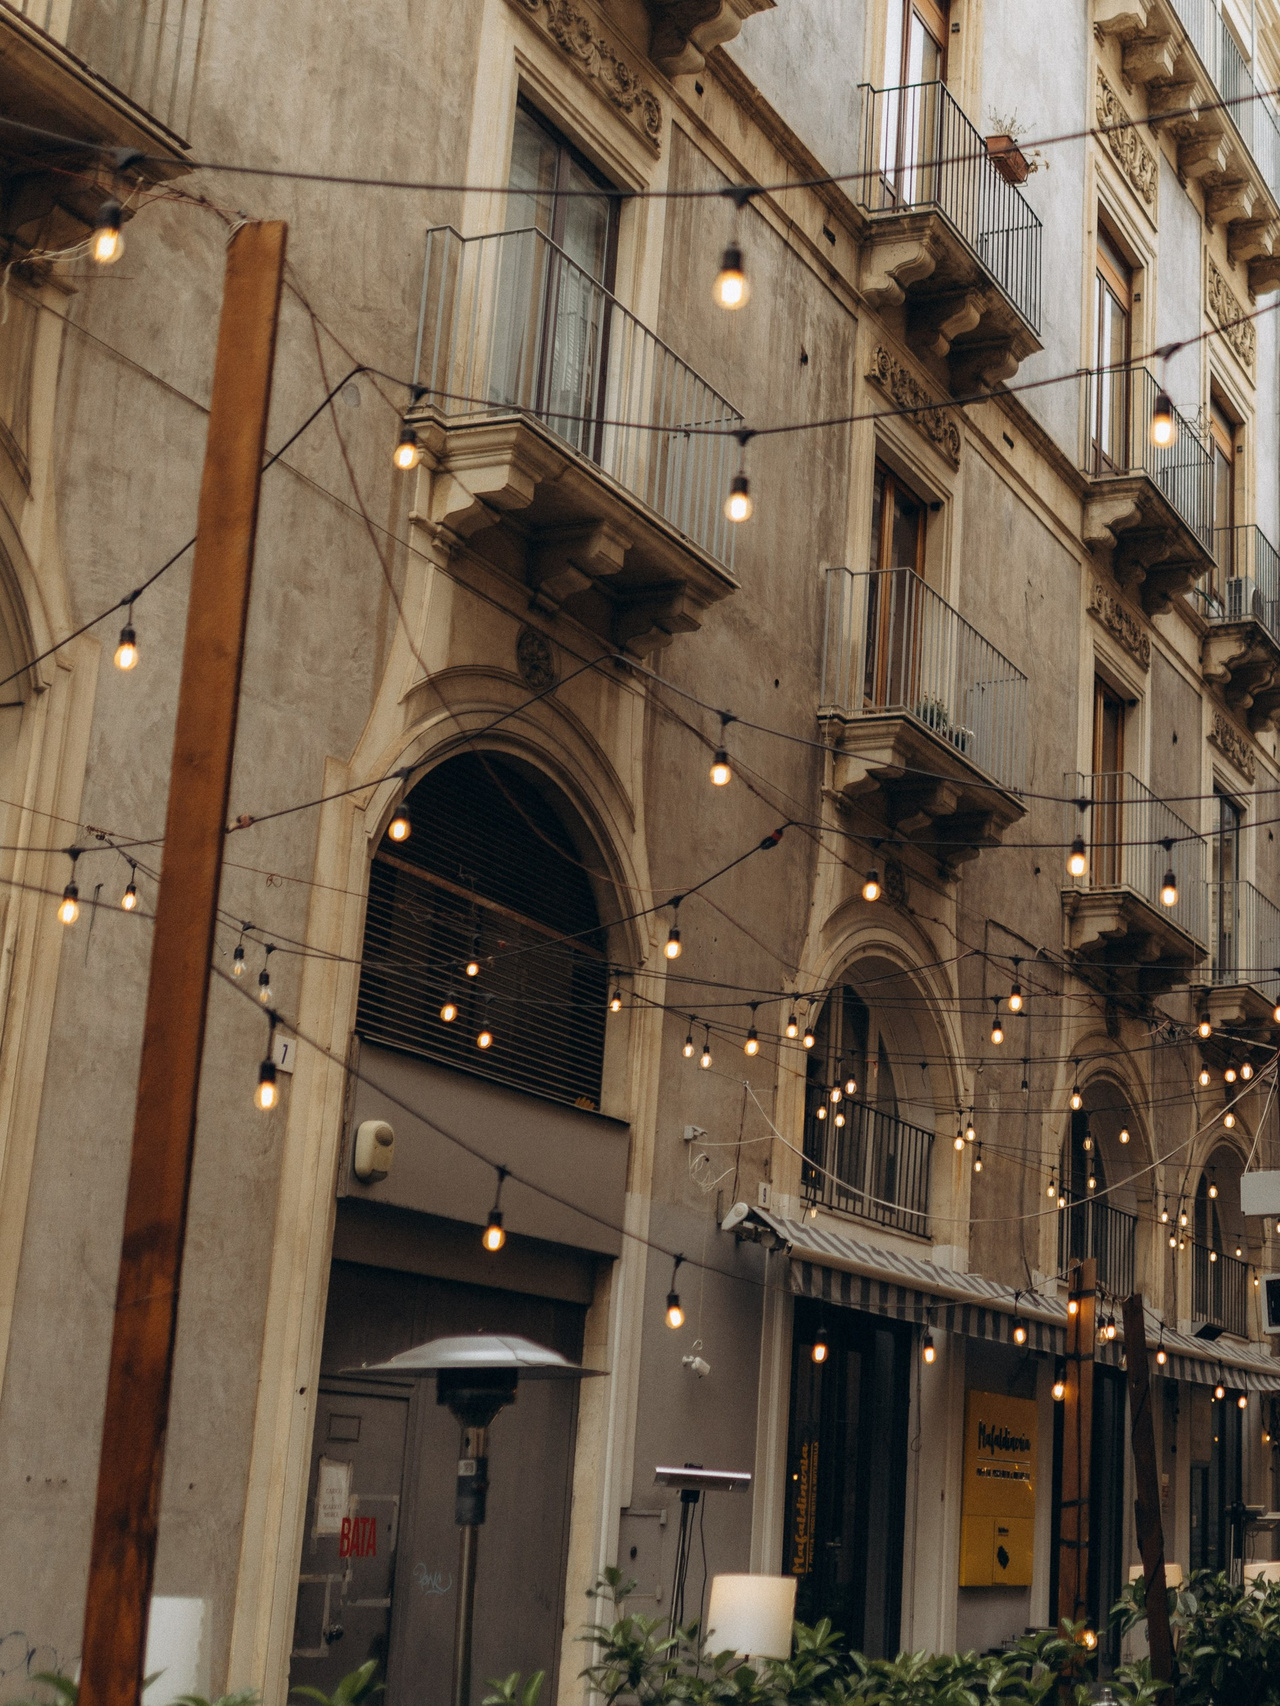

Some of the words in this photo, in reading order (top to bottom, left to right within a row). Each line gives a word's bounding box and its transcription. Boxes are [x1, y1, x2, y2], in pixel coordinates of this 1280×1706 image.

[281, 1044, 288, 1064] 7
[792, 1443, 809, 1573] Mafaldineria
[339, 1516, 377, 1558] BATA
